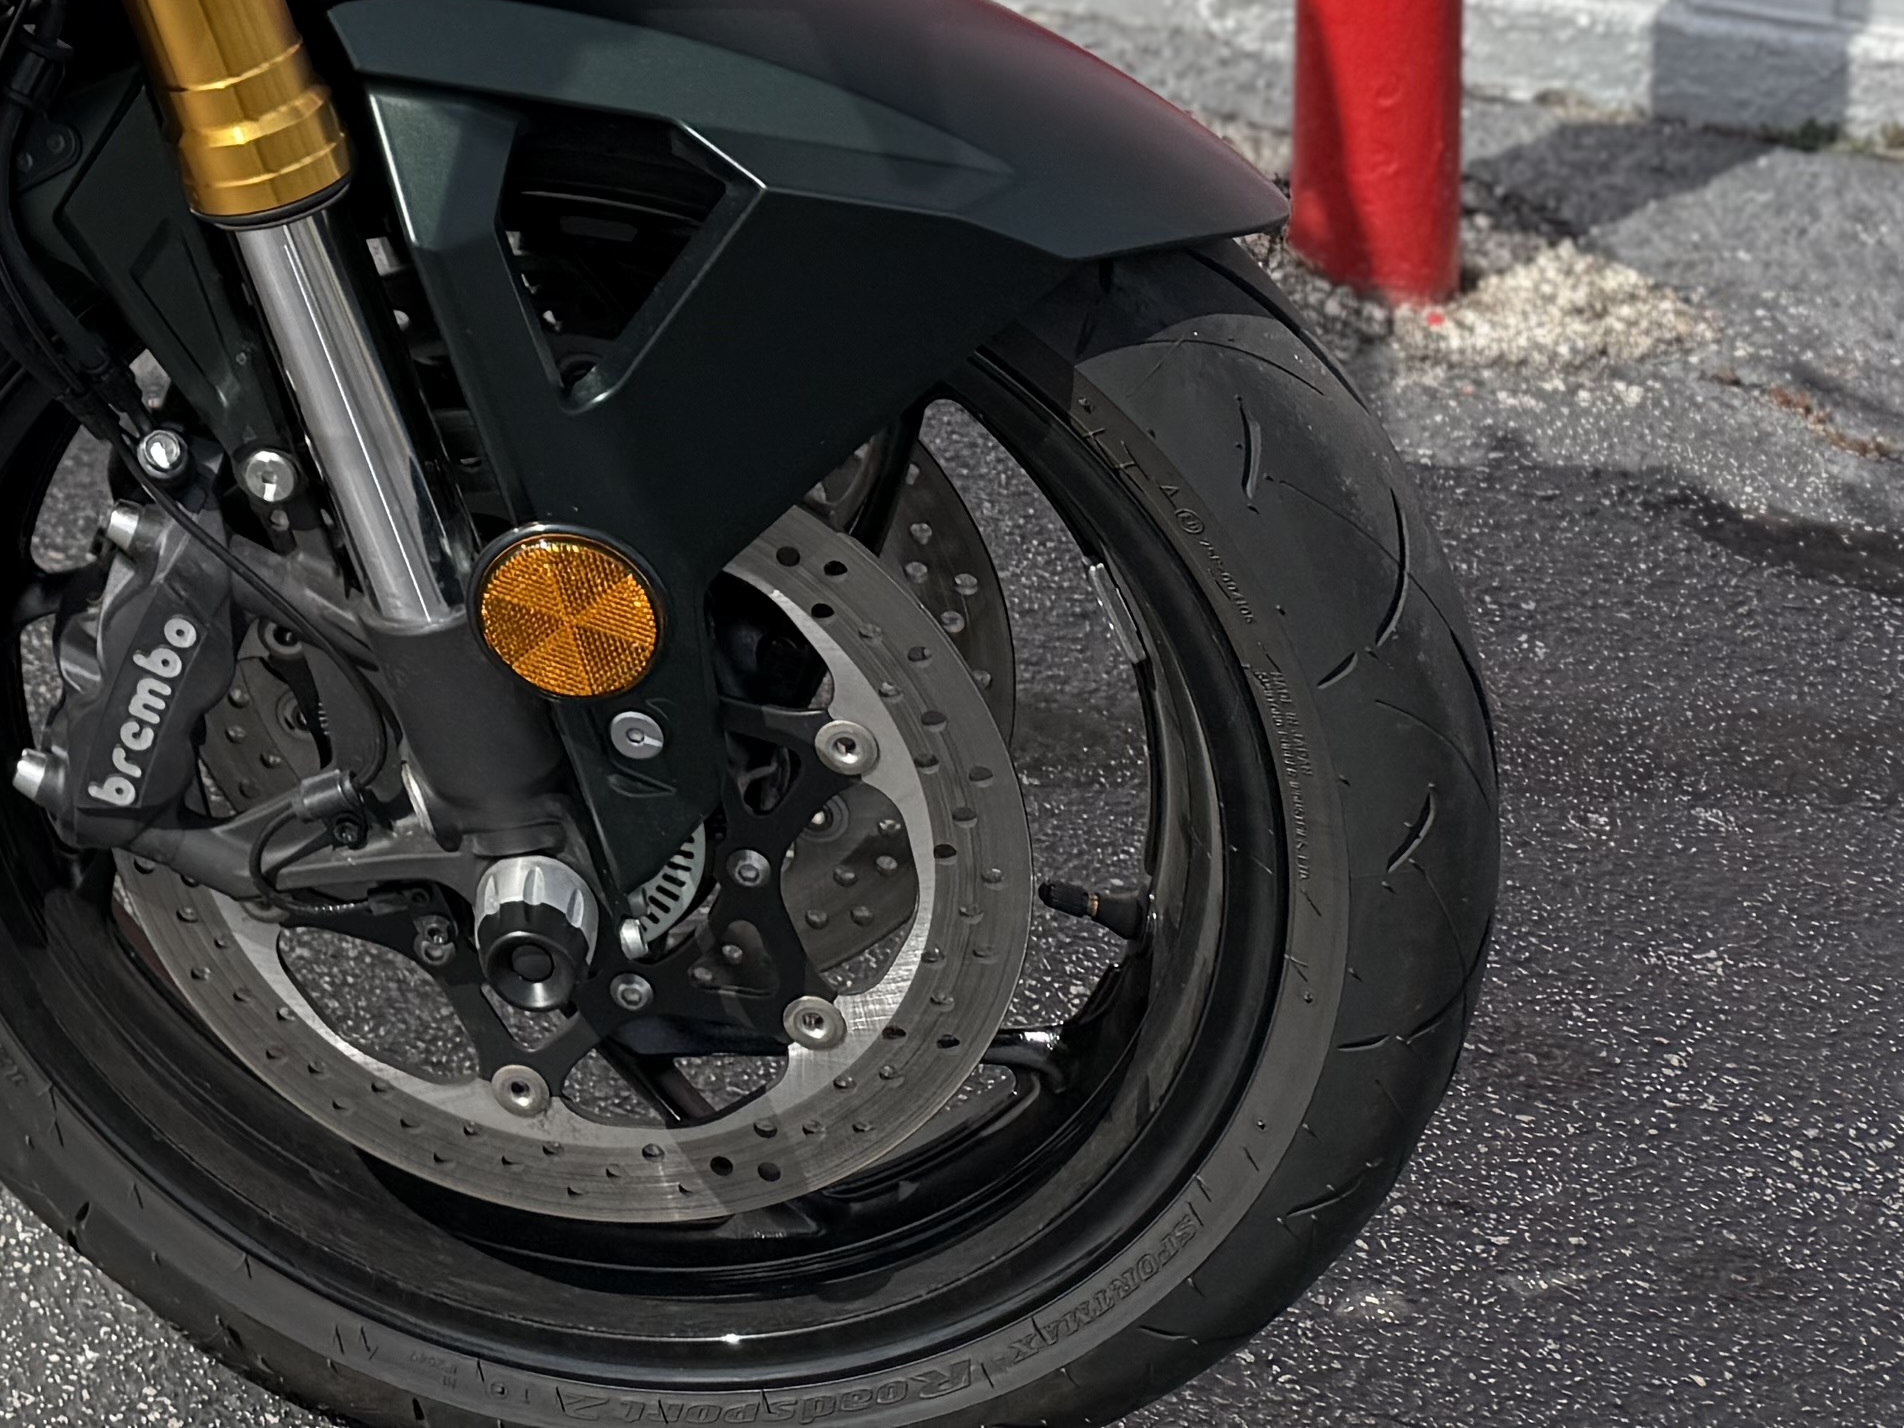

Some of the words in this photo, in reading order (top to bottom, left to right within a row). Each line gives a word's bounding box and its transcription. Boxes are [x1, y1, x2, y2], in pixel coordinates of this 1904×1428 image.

[87, 616, 198, 807] brembo
[1006, 1210, 1193, 1367] SPORTMAX
[613, 1356, 976, 1427] Roadsport
